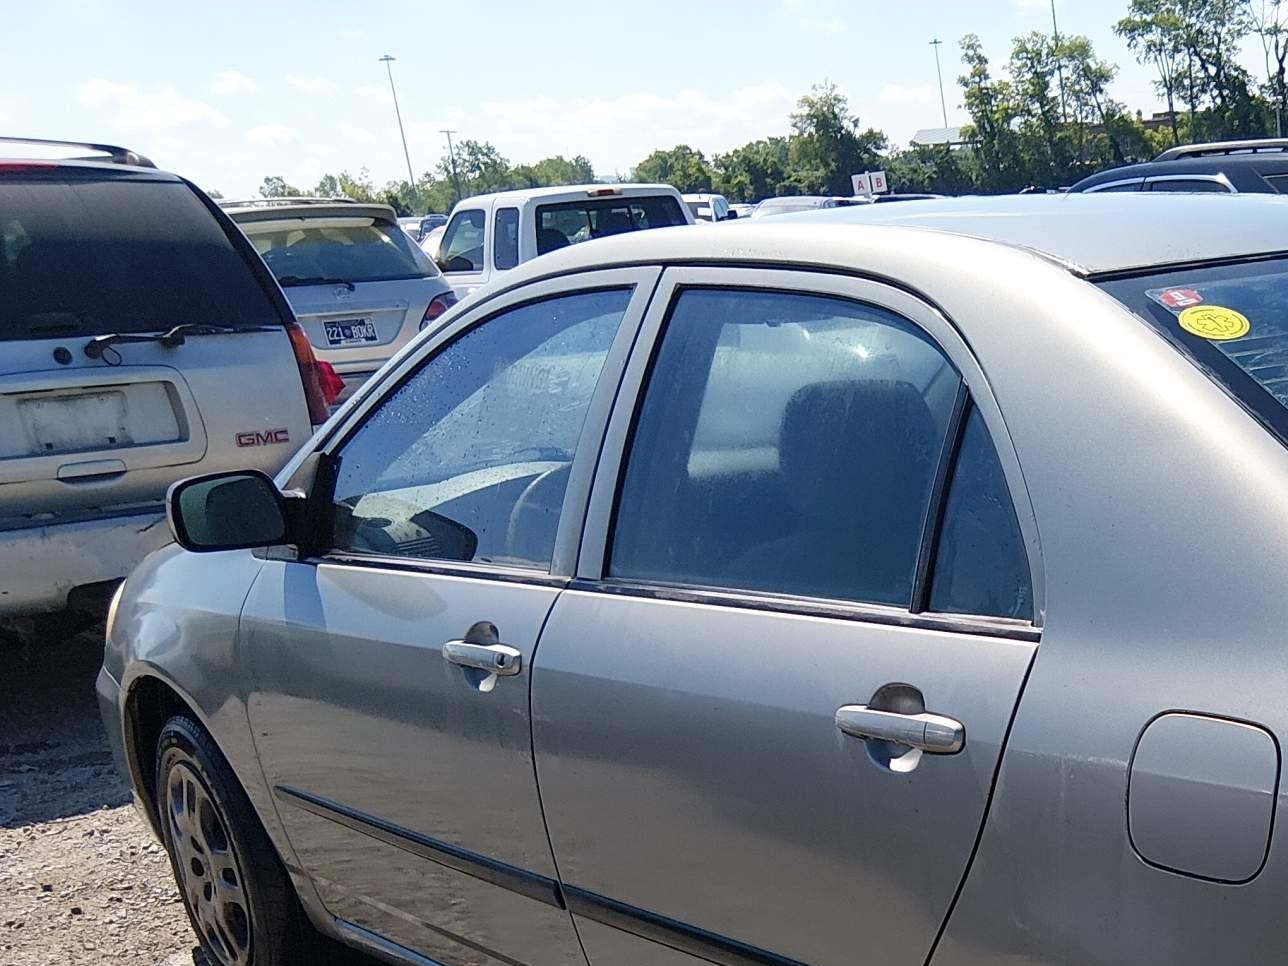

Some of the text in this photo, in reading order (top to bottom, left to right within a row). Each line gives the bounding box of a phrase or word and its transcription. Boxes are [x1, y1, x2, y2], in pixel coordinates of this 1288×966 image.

[857, 180, 865, 191] A
[875, 177, 883, 188] B
[326, 326, 347, 341] 221
[235, 429, 290, 447] GMC
